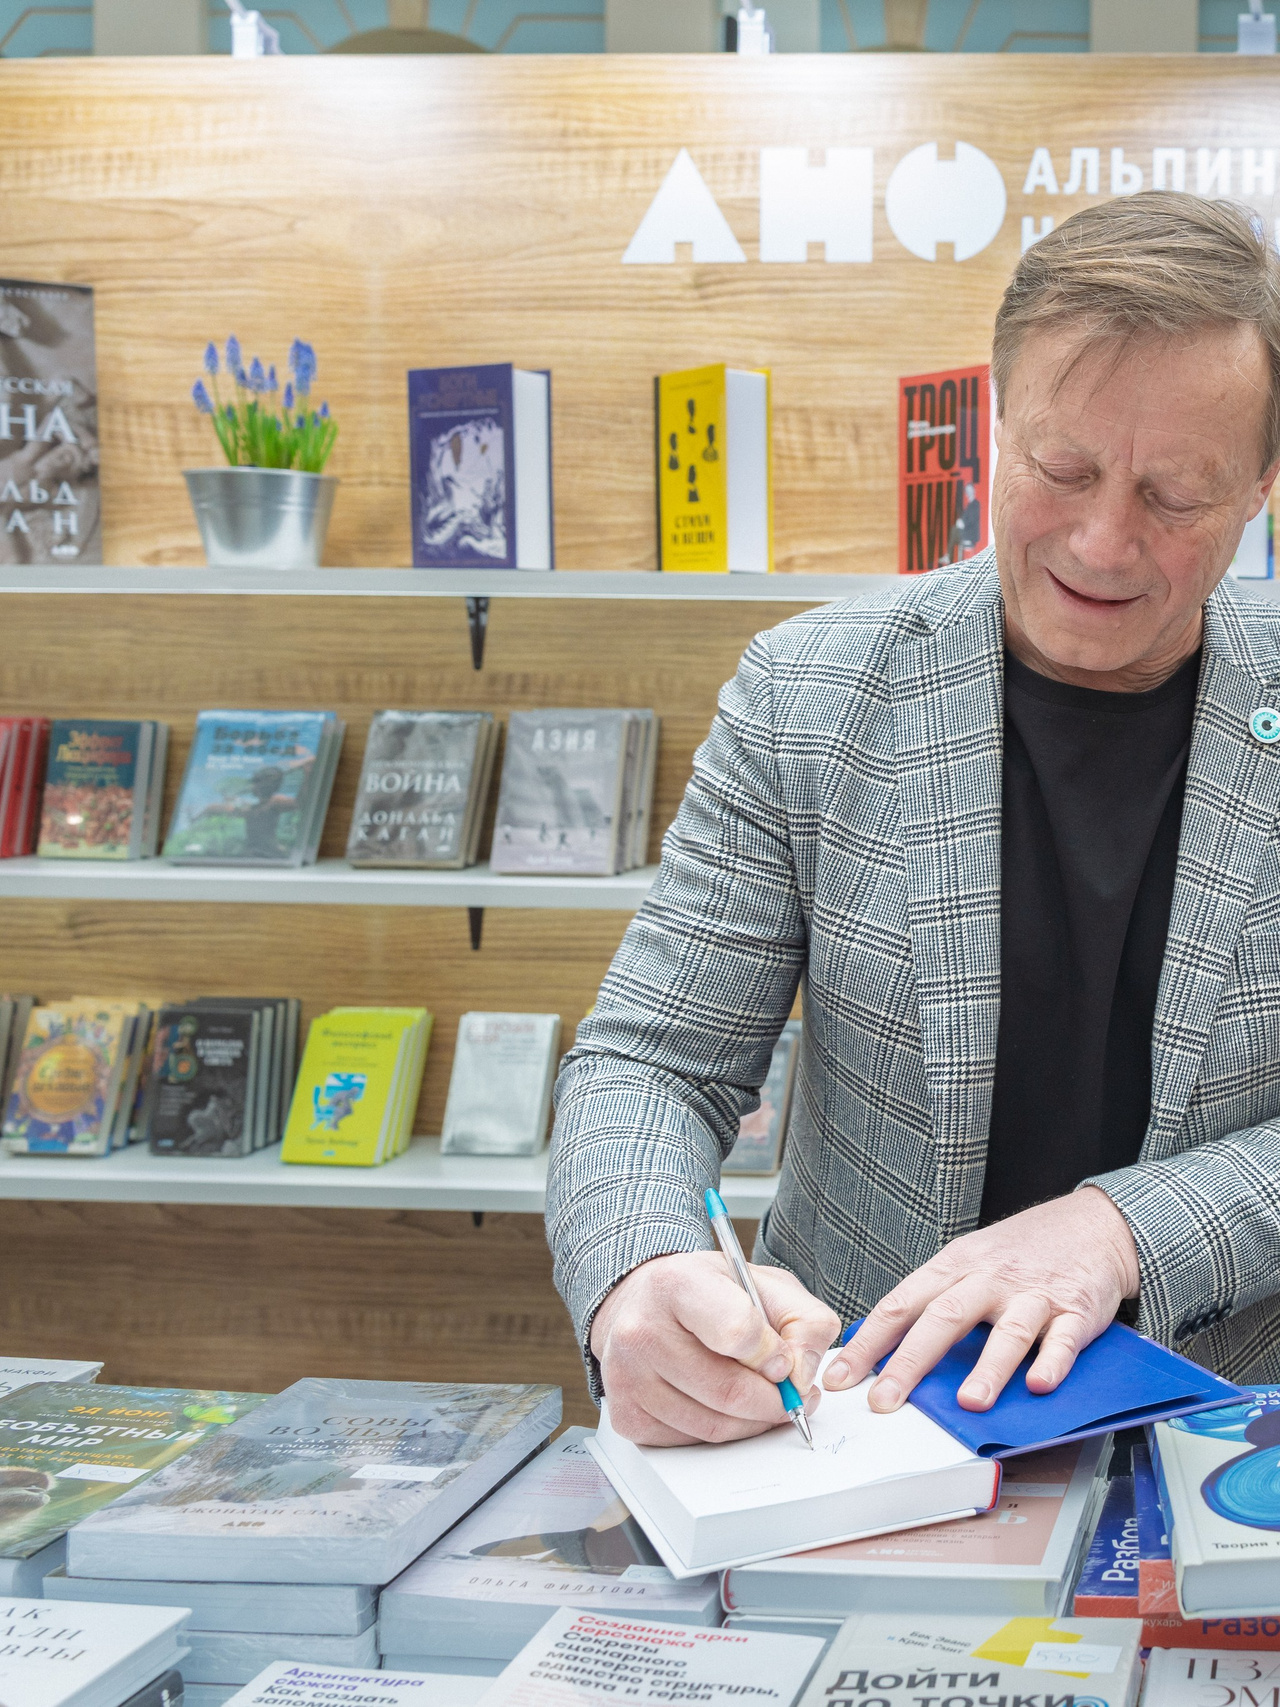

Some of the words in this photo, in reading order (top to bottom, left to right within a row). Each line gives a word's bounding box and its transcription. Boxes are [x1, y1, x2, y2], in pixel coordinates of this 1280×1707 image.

[904, 377, 979, 484] ТРОЦ
[531, 729, 597, 751] АЗИЯ
[365, 769, 462, 793] ВОЙНА
[67, 1406, 103, 1415] ЭД
[107, 1407, 173, 1418] ЙОНГ
[322, 1416, 434, 1427] СОВЫ
[0, 1419, 205, 1442] ЕОБЪЯТНЫЙ
[17, 1434, 104, 1447] МИР
[267, 1426, 321, 1436] ВО
[329, 1427, 456, 1440] ЛЬДАХ
[0, 1446, 57, 1455] ВОТНЫЕ
[60, 1450, 135, 1460] ОЩУЩАЮТ
[48, 1456, 136, 1467] РЕАЛЬНОСТЬ
[1212, 1540, 1269, 1550] Теория
[468, 1577, 528, 1588] ОЛЬГА
[543, 1583, 647, 1595] ФИЛАТОВА
[577, 1616, 687, 1637] Создание
[694, 1633, 749, 1643] арки
[1143, 1618, 1183, 1628] кухарь
[563, 1631, 660, 1654] Секреты
[569, 1625, 695, 1648] персонажа
[898, 1637, 929, 1648] Крис
[932, 1642, 965, 1655] Смит
[935, 1635, 972, 1648] Эванс
[0, 1644, 87, 1660] ВРЫ
[554, 1641, 688, 1667] сценарного
[545, 1651, 687, 1678] мастерства:
[274, 1678, 359, 1692] сюжета
[283, 1667, 426, 1687] Архитектура
[529, 1670, 617, 1692] сюжета
[625, 1687, 640, 1695] и
[647, 1689, 713, 1701] героя
[537, 1661, 644, 1685] единство
[650, 1679, 780, 1698] структуры,
[825, 1667, 1000, 1695] Дойти
[263, 1685, 306, 1697] Как
[311, 1691, 400, 1705] создать
